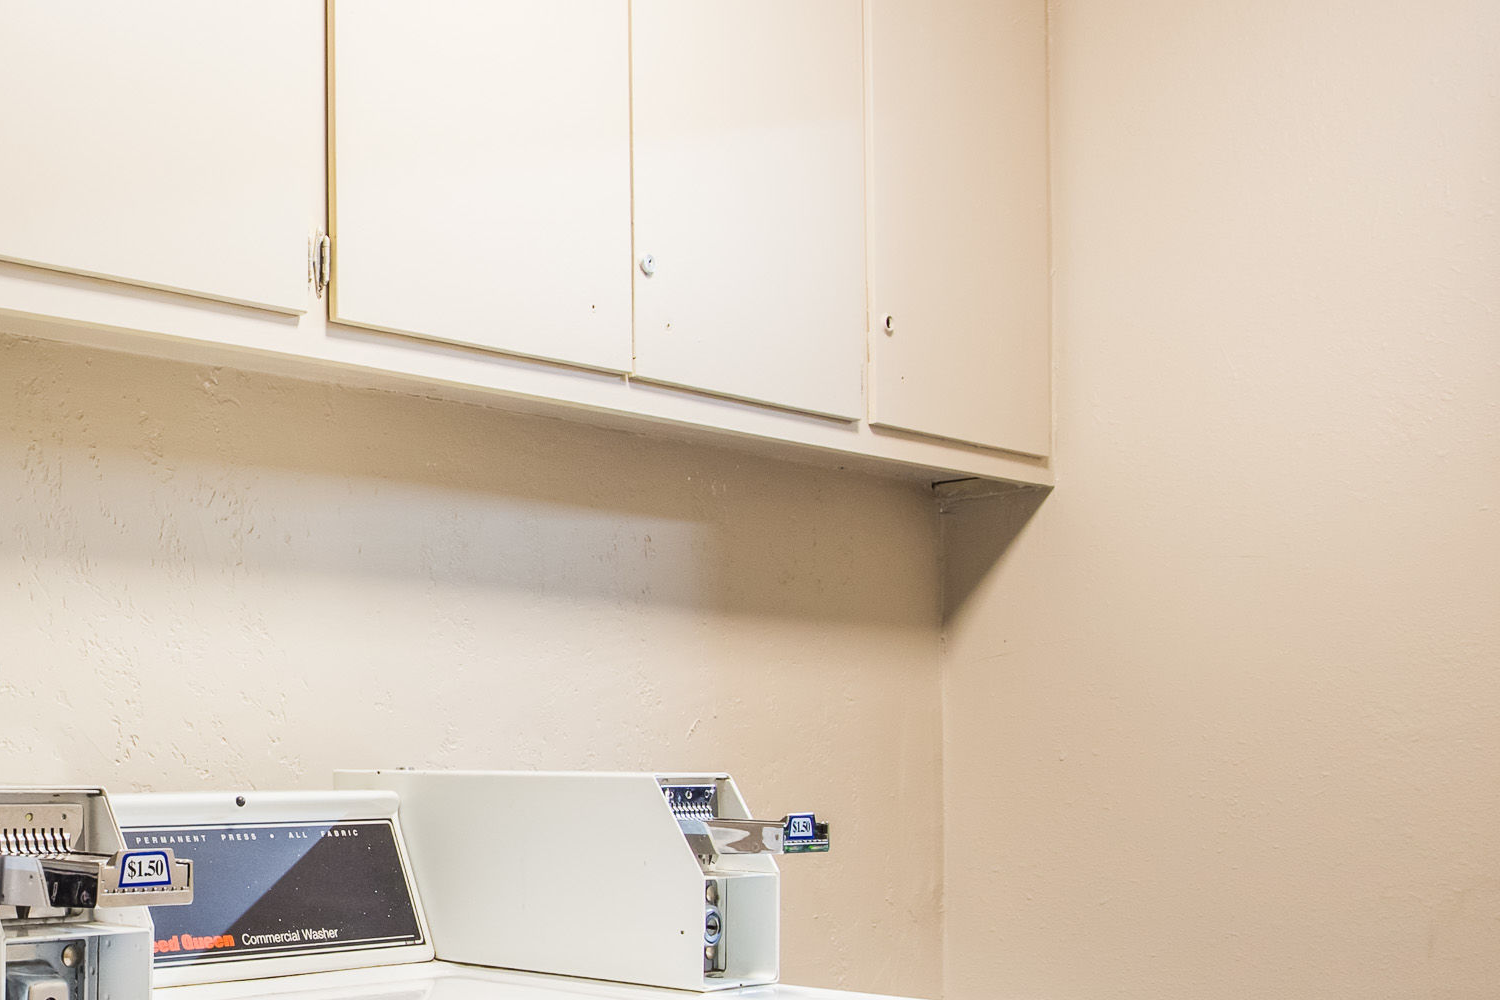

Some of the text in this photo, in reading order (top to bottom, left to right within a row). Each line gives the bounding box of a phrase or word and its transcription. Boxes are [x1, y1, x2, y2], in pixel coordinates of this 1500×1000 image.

[792, 820, 810, 833] $1.50
[135, 828, 359, 845] PERMANENT PRESS ALL FABRIC
[127, 859, 164, 879] $1.50
[180, 933, 235, 951] Queen
[241, 931, 300, 946] Commercial
[301, 927, 339, 941] Washer
